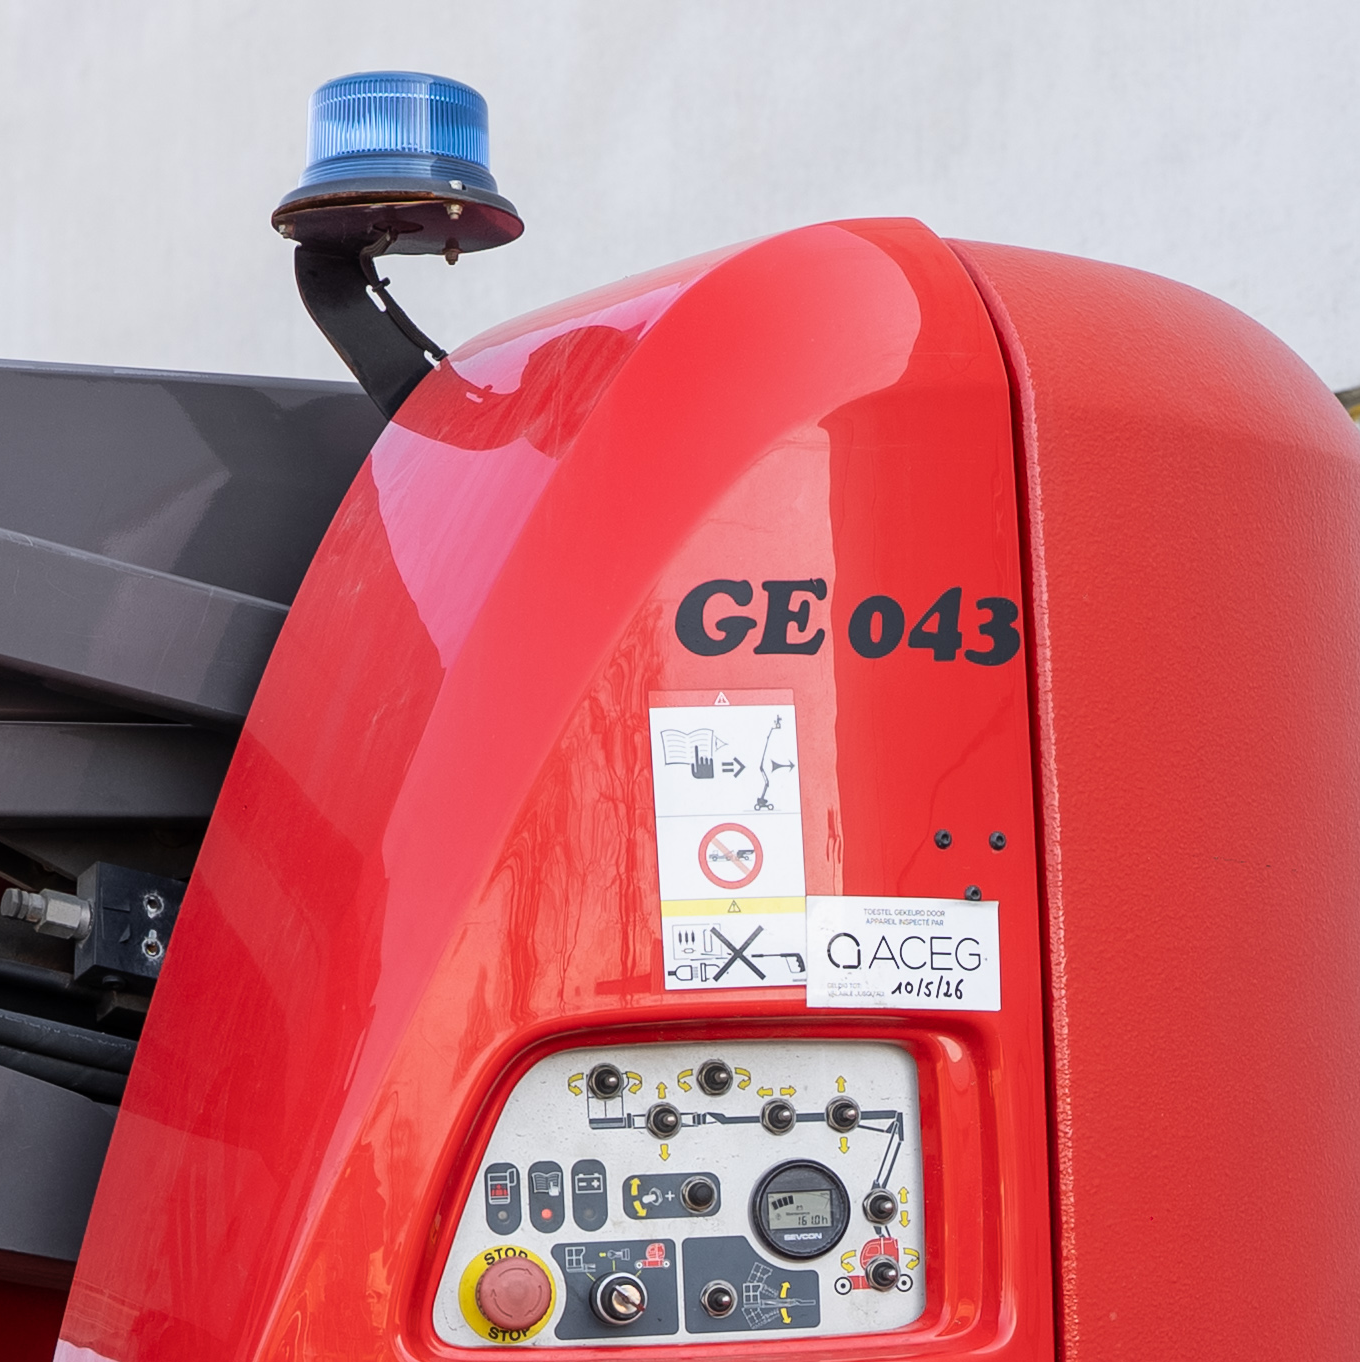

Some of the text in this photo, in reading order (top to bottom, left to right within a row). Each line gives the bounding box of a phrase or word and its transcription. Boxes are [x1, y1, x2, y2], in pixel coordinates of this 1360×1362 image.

[675, 578, 1021, 667] GE 043
[863, 908, 893, 916] TOESTEL
[926, 910, 946, 918] DOOR
[891, 976, 964, 1000] 10/5/26
[784, 1232, 823, 1241] SEVCON
